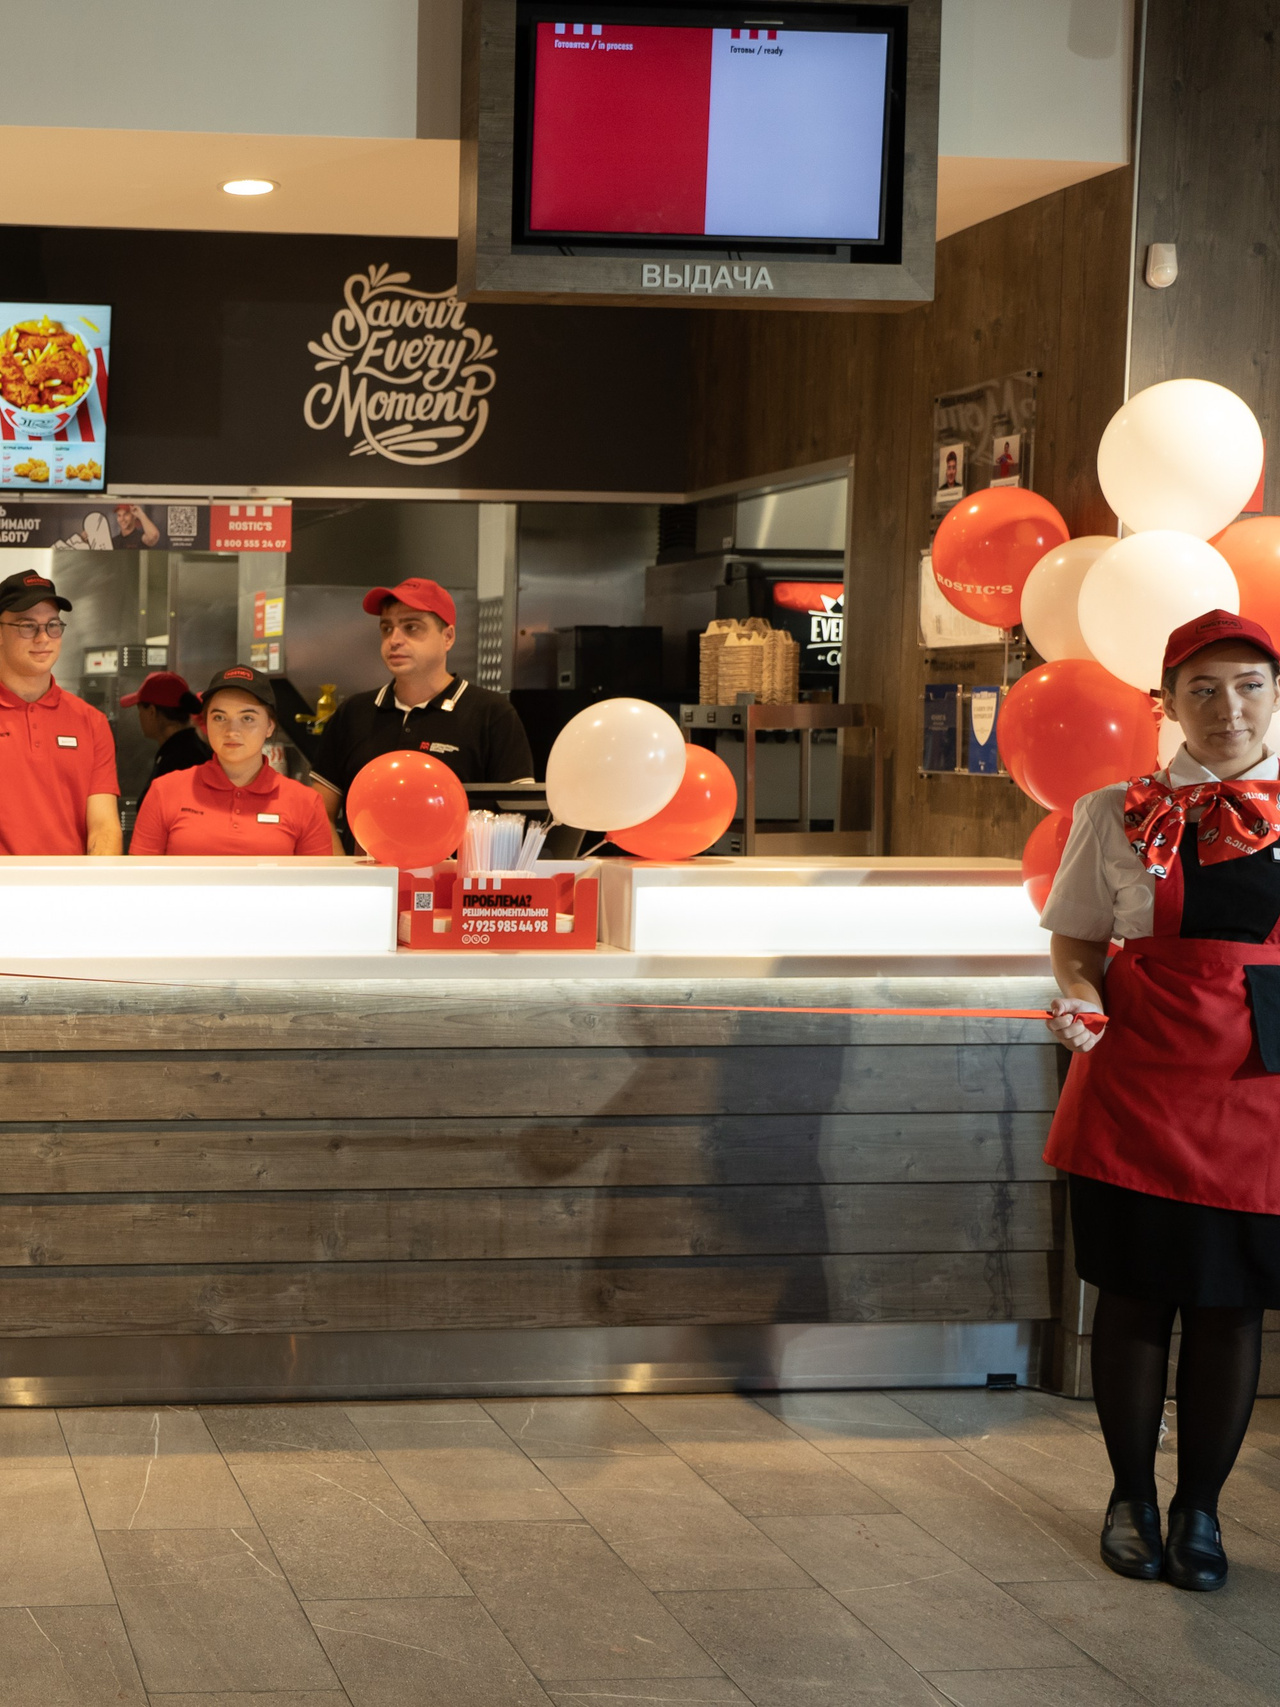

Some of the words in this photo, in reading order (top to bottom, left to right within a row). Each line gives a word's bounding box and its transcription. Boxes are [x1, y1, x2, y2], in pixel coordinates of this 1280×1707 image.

[554, 39, 589, 50] Готовятся
[598, 40, 605, 50] in
[606, 42, 634, 53] process
[730, 45, 755, 55] Готовы
[764, 47, 783, 57] ready
[641, 264, 774, 293] ВЫДАЧА
[332, 273, 468, 351] Savour
[352, 328, 468, 392] Every
[303, 364, 496, 440] Moment
[228, 521, 273, 532] ROSTIC'S
[224, 539, 242, 548] 800
[243, 539, 260, 548] 555
[262, 540, 273, 548] 24
[275, 540, 287, 548] 07
[937, 572, 1014, 595] ROSTIC'S
[463, 894, 532, 907] ПРОБЛЕМА?
[462, 908, 490, 917] РЕШИМ
[491, 908, 549, 917] МОМЕНТАЛЬНО!
[462, 920, 475, 932] +7
[476, 920, 496, 932] 925
[497, 920, 517, 932] 985
[518, 920, 533, 932] 44
[534, 920, 548, 932] 98
